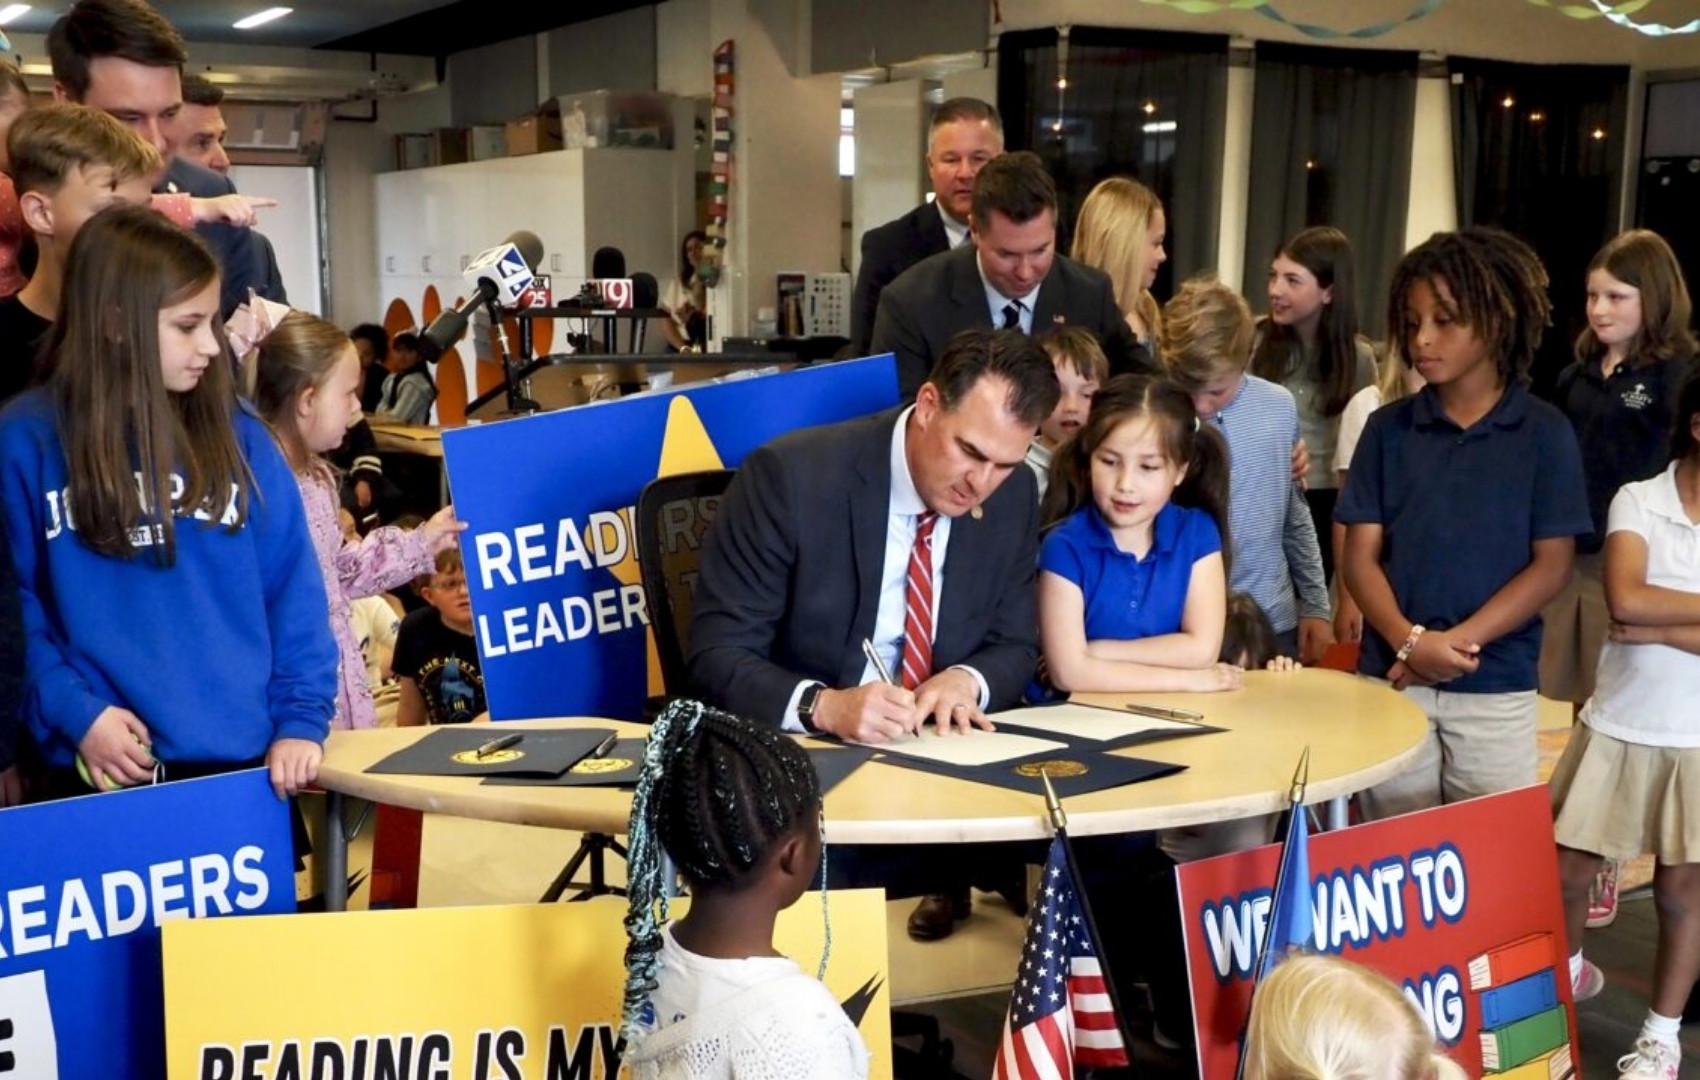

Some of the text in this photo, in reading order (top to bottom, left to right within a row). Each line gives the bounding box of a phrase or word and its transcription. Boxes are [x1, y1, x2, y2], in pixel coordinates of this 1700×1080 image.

[527, 291, 547, 307] 25
[607, 281, 629, 309] 9
[478, 584, 653, 658] LEADER
[0, 845, 269, 958] EADERS
[1411, 849, 1465, 923] TO
[474, 1030, 525, 1080] IS
[546, 1025, 628, 1080] MY
